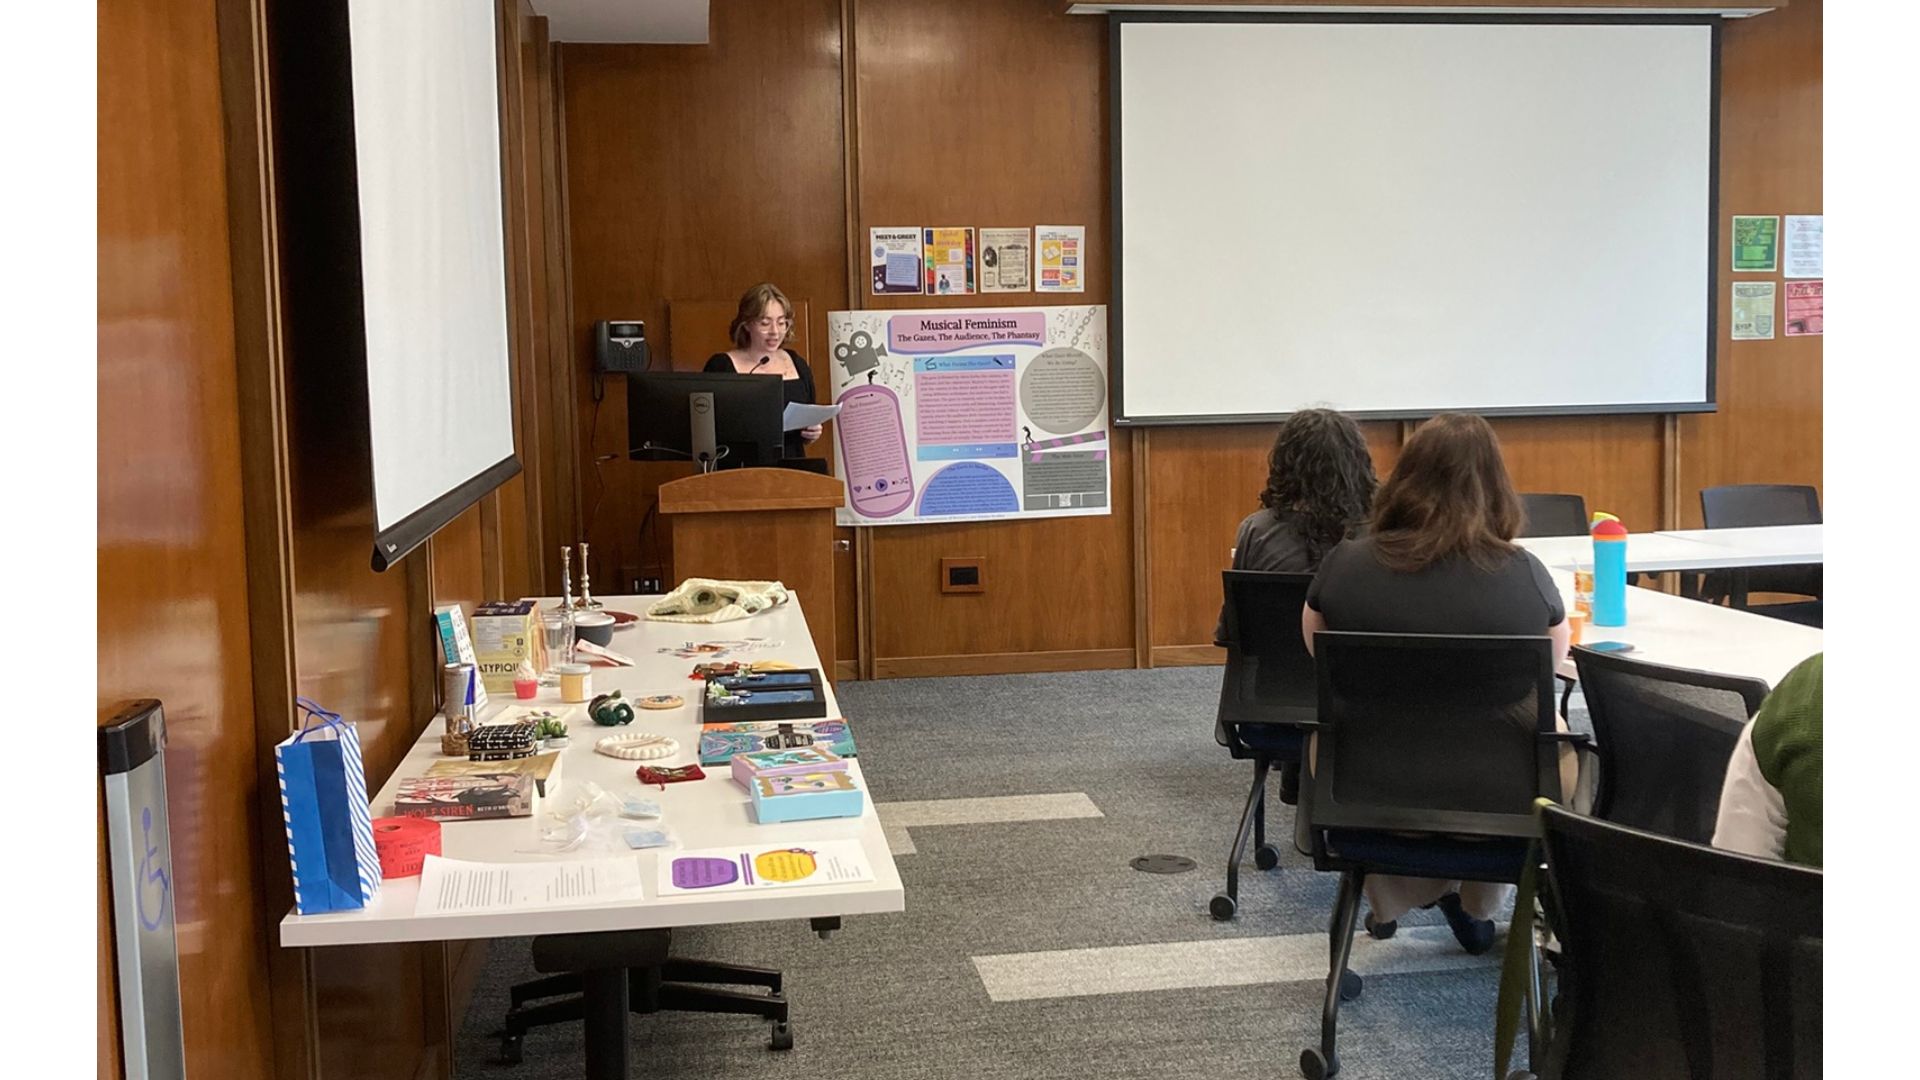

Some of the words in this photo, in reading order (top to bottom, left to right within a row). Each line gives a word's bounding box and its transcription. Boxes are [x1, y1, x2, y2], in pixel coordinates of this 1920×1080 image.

[920, 319, 962, 331] Musical
[965, 318, 1017, 330] Feminism
[897, 334, 912, 342] The
[913, 334, 937, 342] Gazes,
[938, 333, 952, 341] The
[953, 332, 990, 341] Audience,
[992, 331, 1006, 339] The
[1007, 331, 1040, 340] Phantasy
[478, 662, 520, 673] ATYPIQU
[439, 804, 474, 816] SIREN
